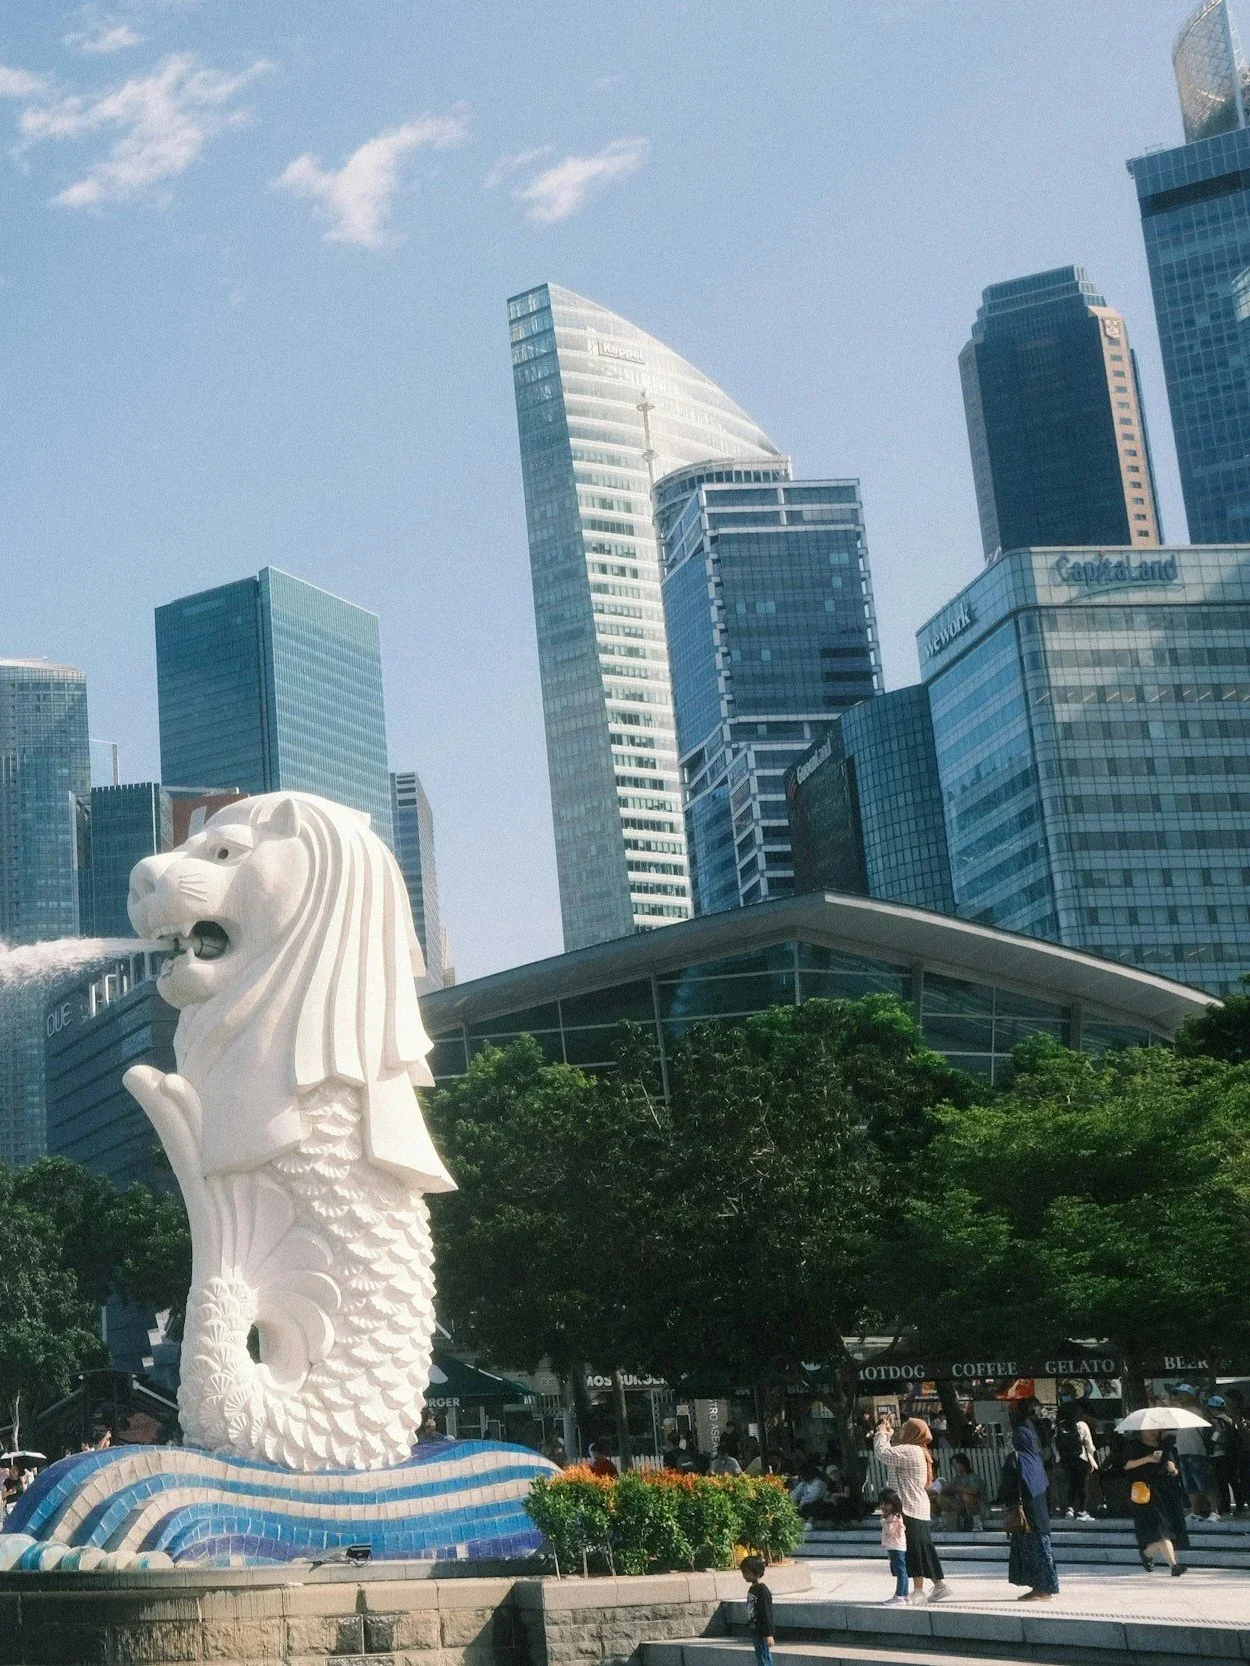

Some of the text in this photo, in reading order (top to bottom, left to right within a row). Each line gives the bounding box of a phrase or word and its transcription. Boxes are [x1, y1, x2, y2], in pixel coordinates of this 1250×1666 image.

[1054, 552, 1178, 586] CapitaLand
[925, 601, 971, 658] wework
[46, 1002, 72, 1037] OUE
[952, 1362, 1018, 1377] COFFEE
[1045, 1358, 1115, 1374] GELATO
[425, 1396, 461, 1408] RGER
